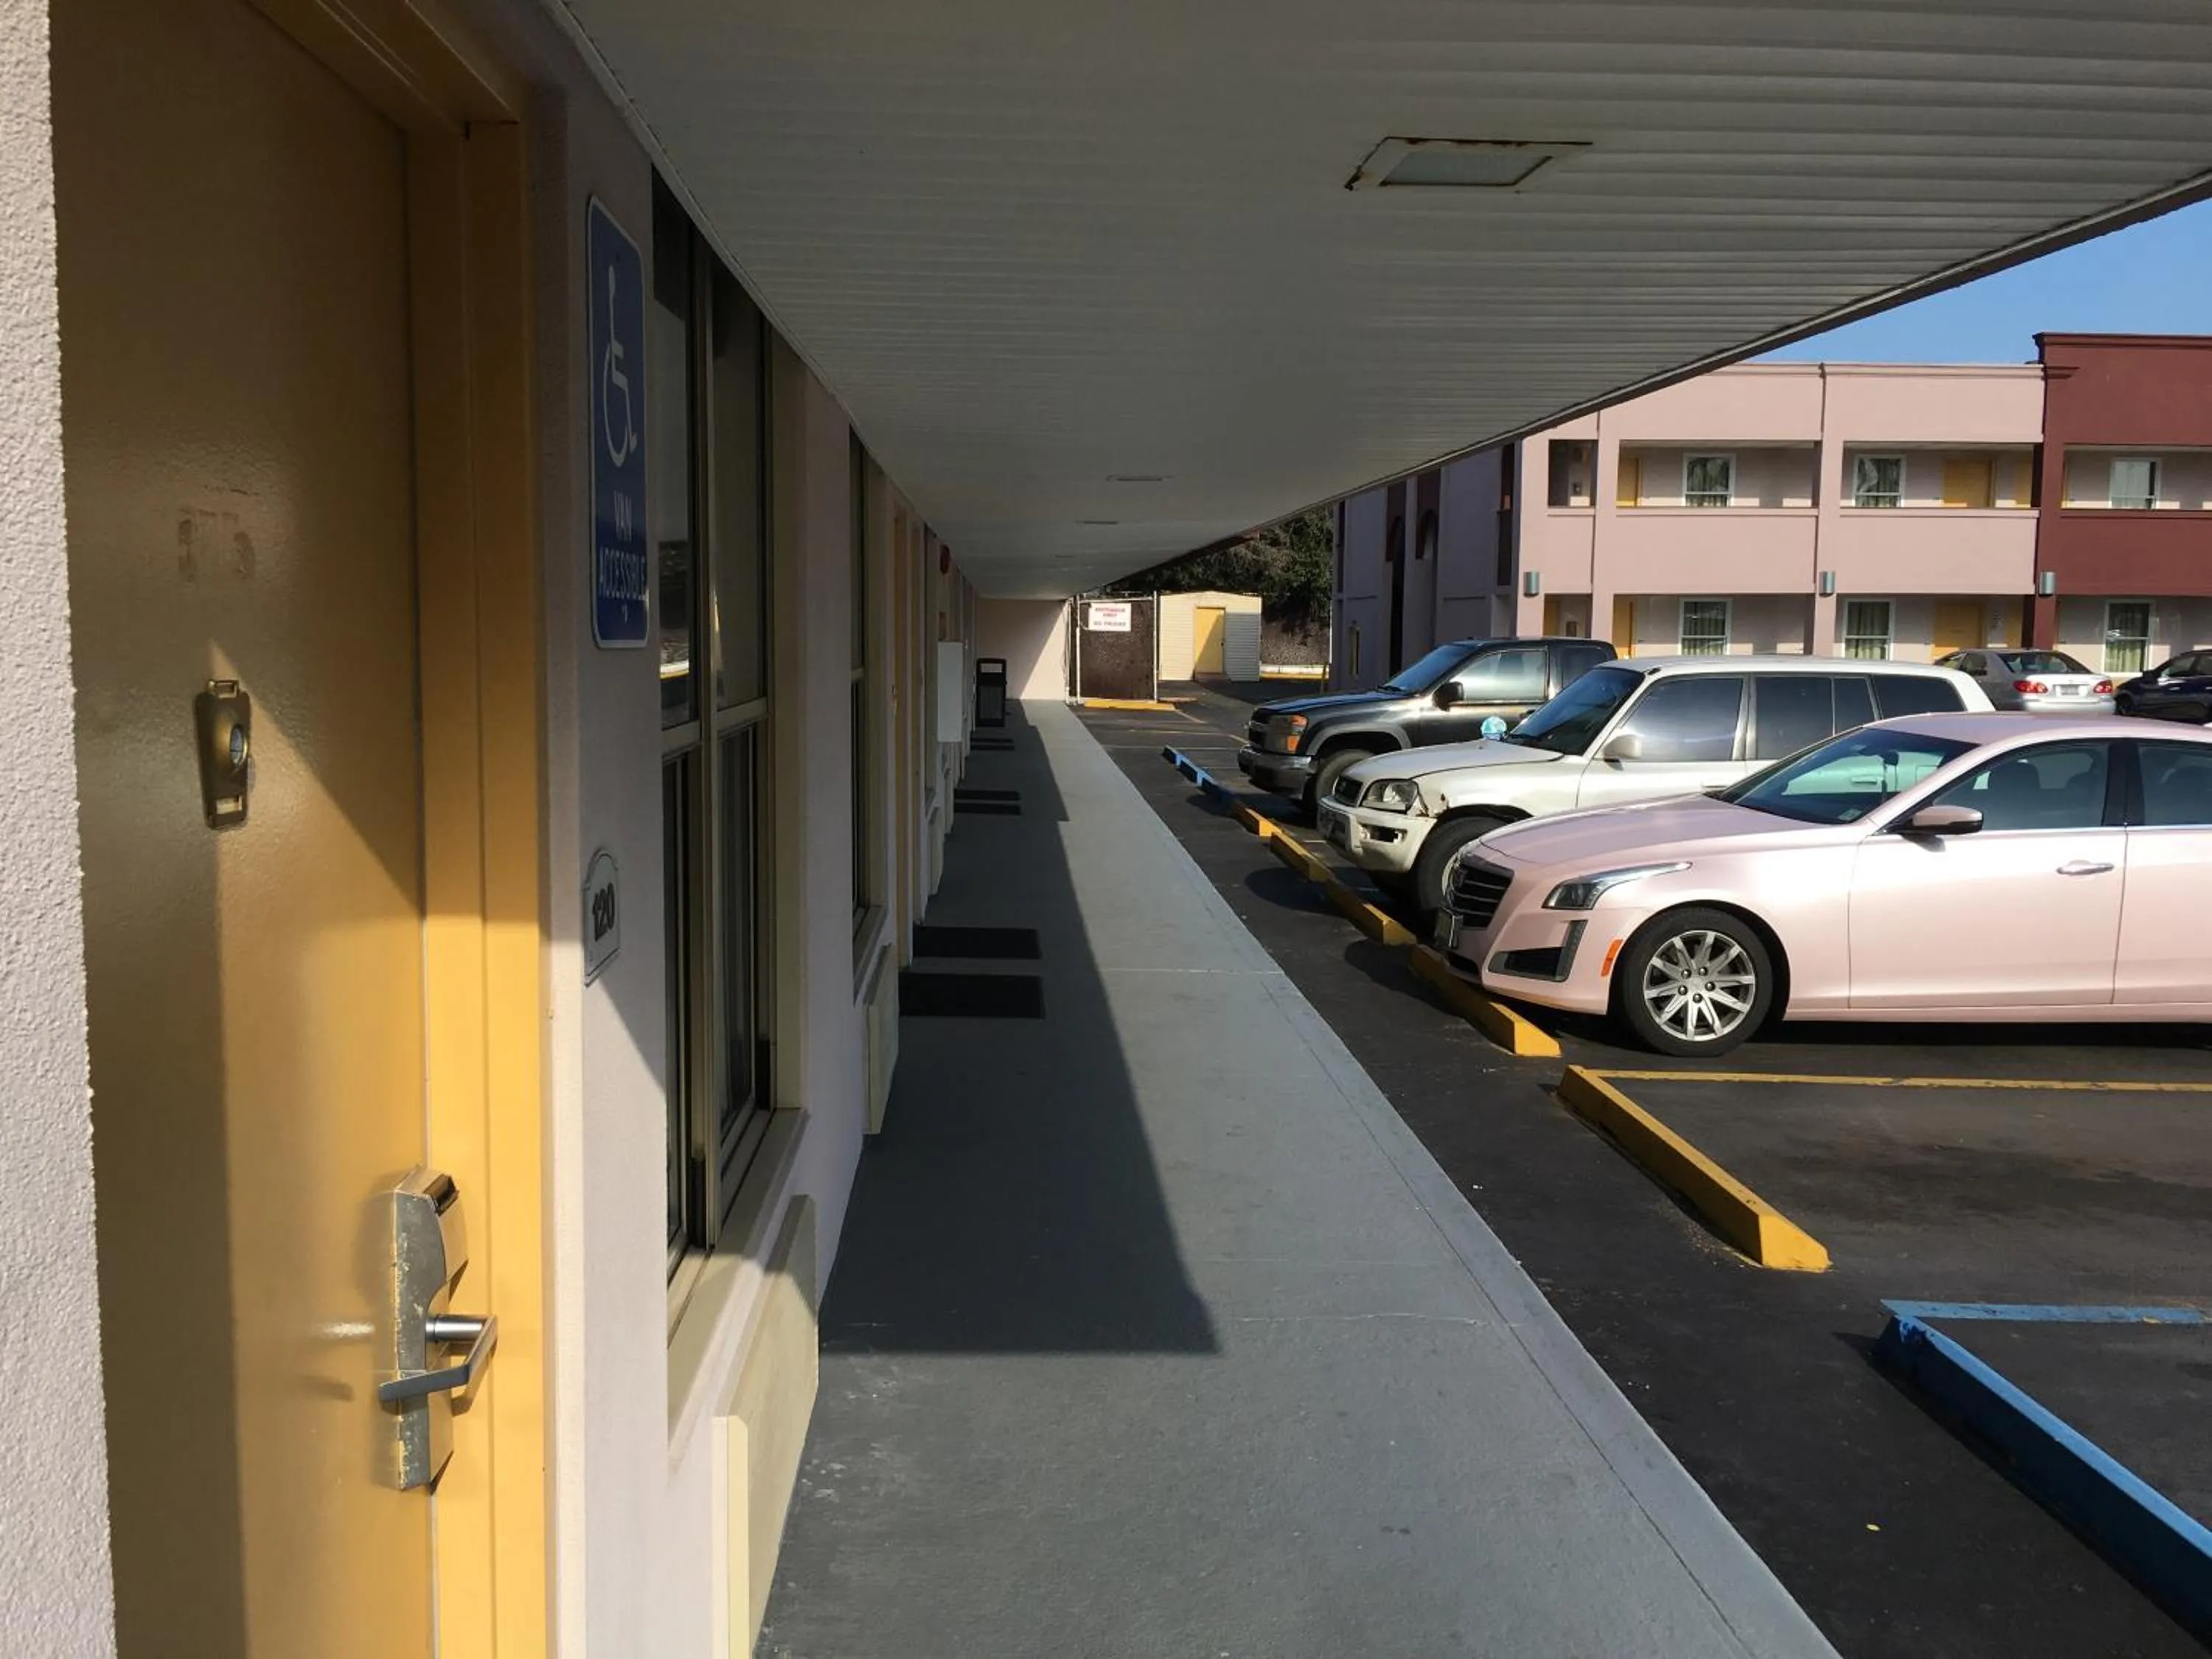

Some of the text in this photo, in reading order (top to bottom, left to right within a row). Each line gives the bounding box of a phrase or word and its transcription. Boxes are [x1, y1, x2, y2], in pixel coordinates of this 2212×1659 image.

[613, 490, 632, 543] VAN
[599, 547, 647, 601] ACCESSIBLE
[593, 883, 615, 942] 120
